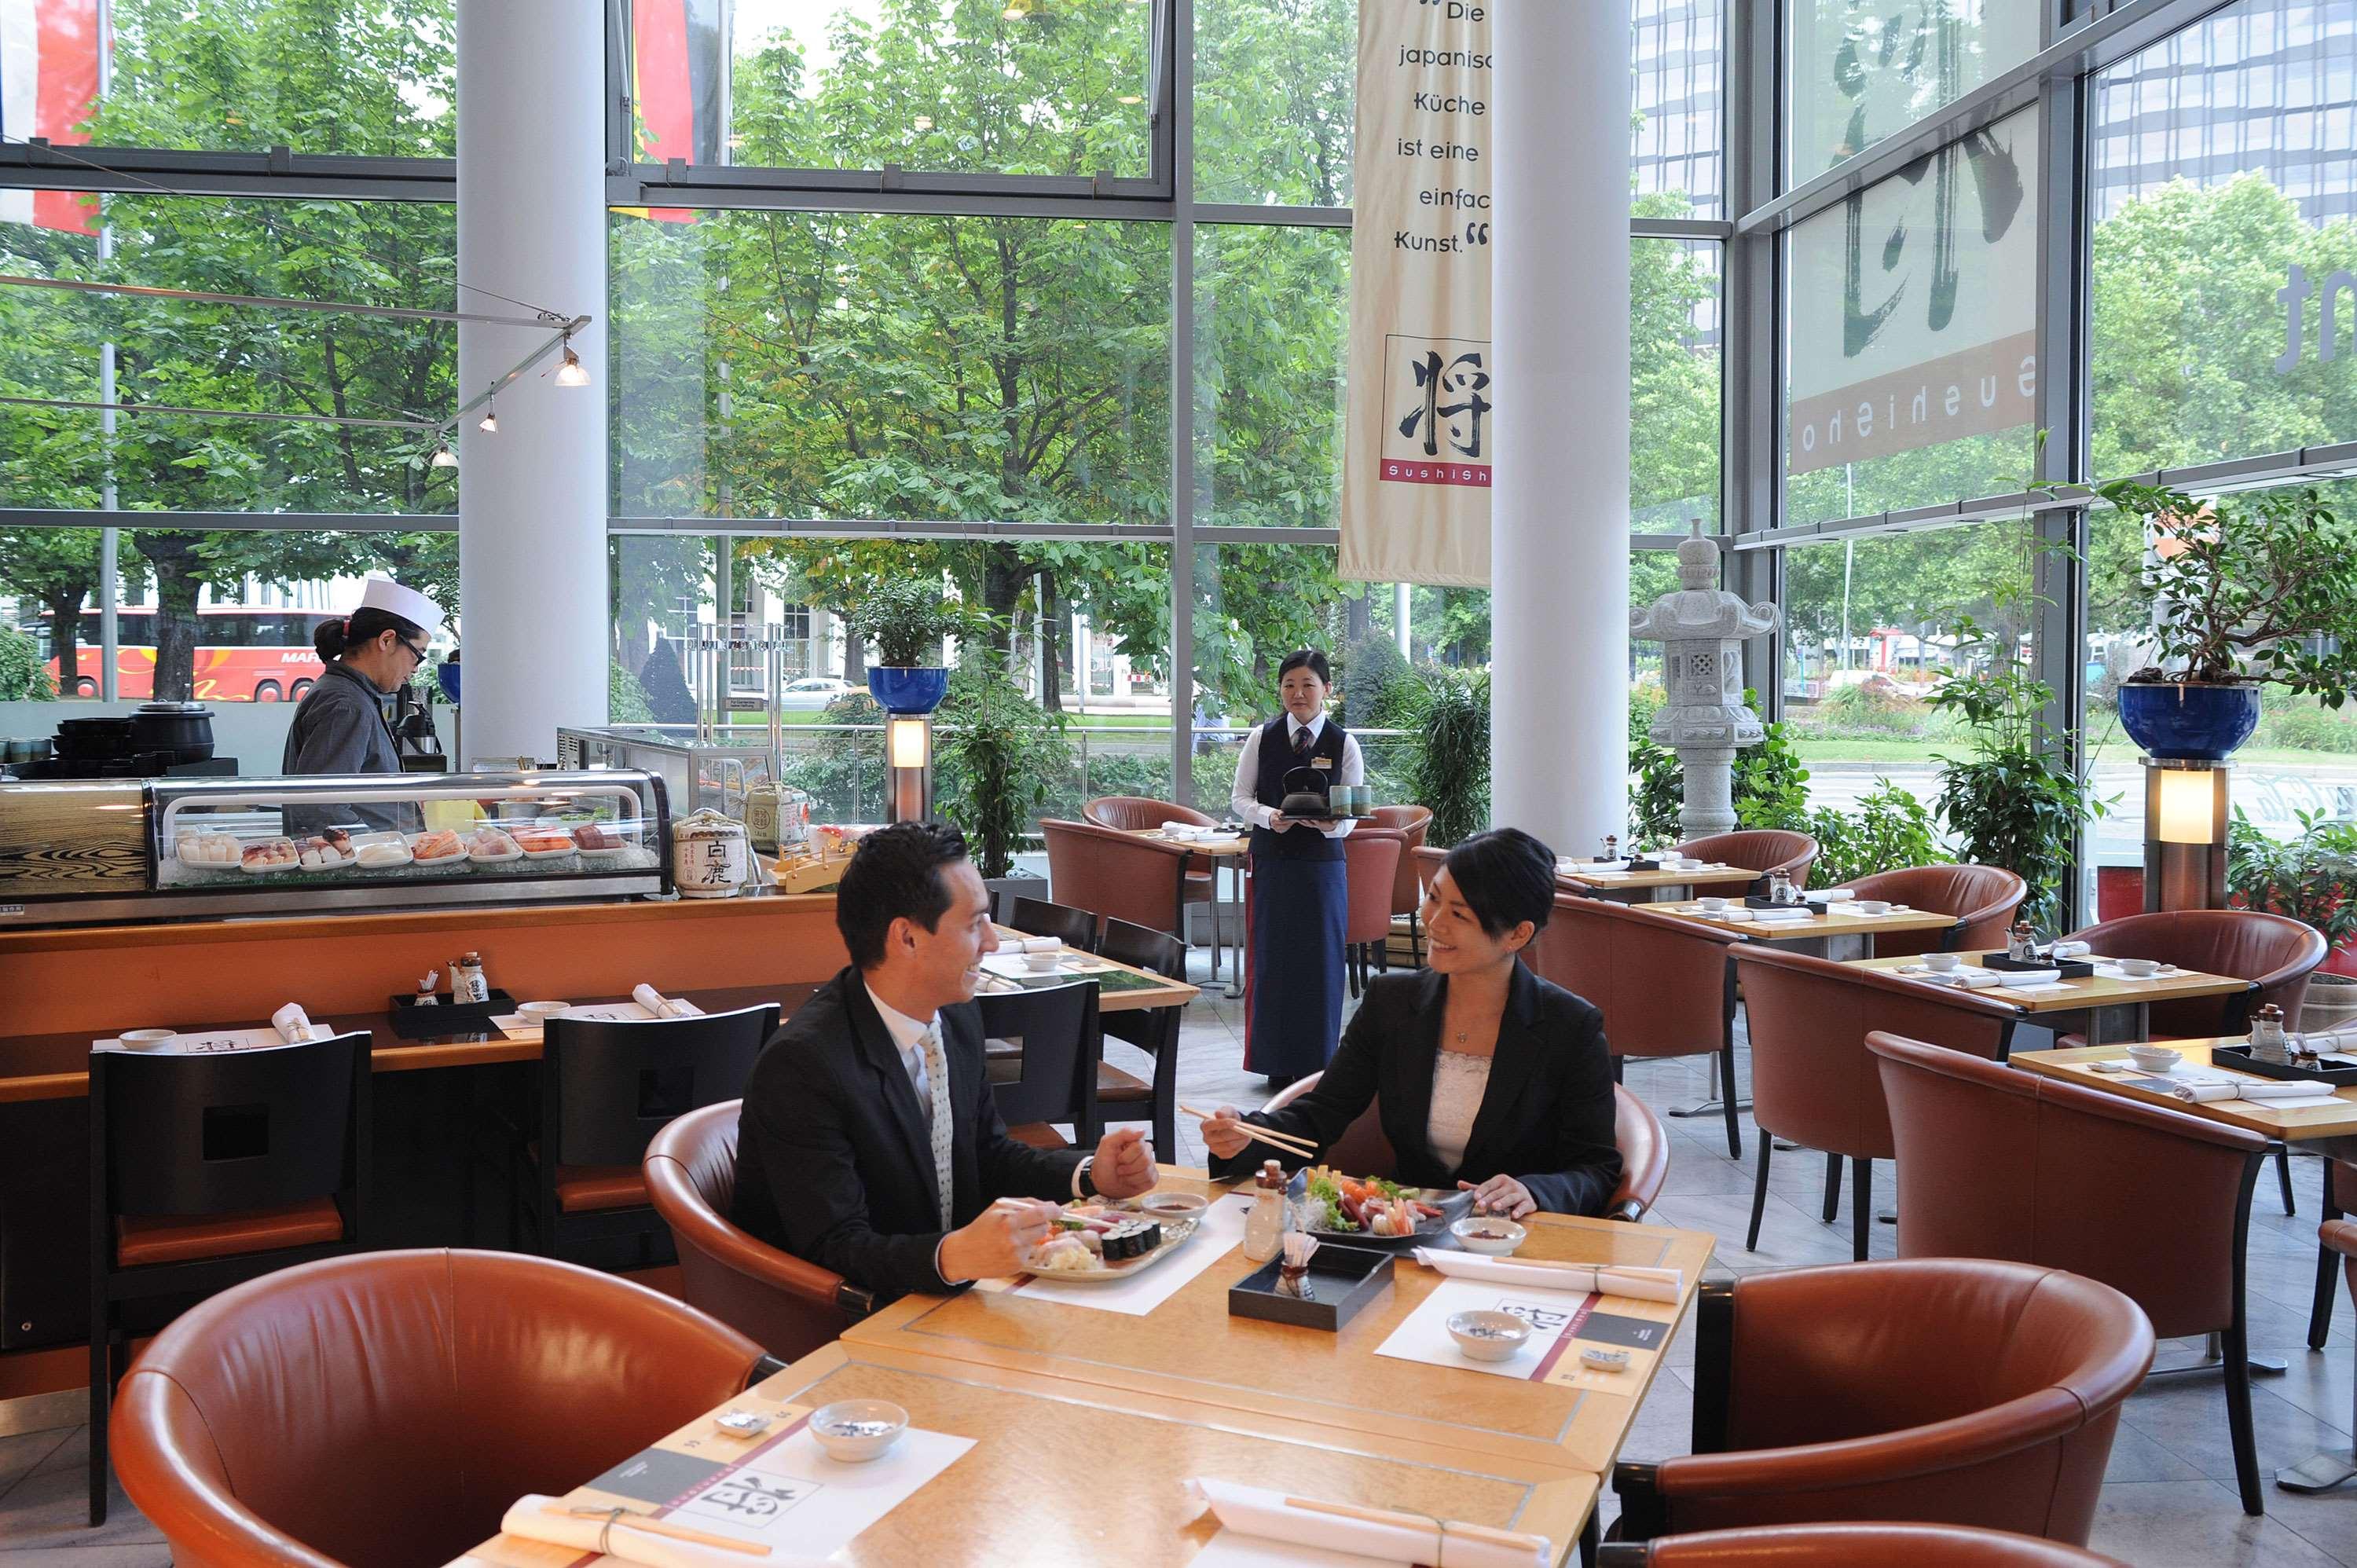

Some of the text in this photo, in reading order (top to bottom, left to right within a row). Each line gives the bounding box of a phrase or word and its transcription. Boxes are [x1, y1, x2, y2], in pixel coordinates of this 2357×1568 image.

[1447, 2, 1485, 22] Die
[1413, 92, 1486, 115] Küche
[1398, 137, 1479, 162] ist eine
[701, 840, 731, 885] 白鹿
